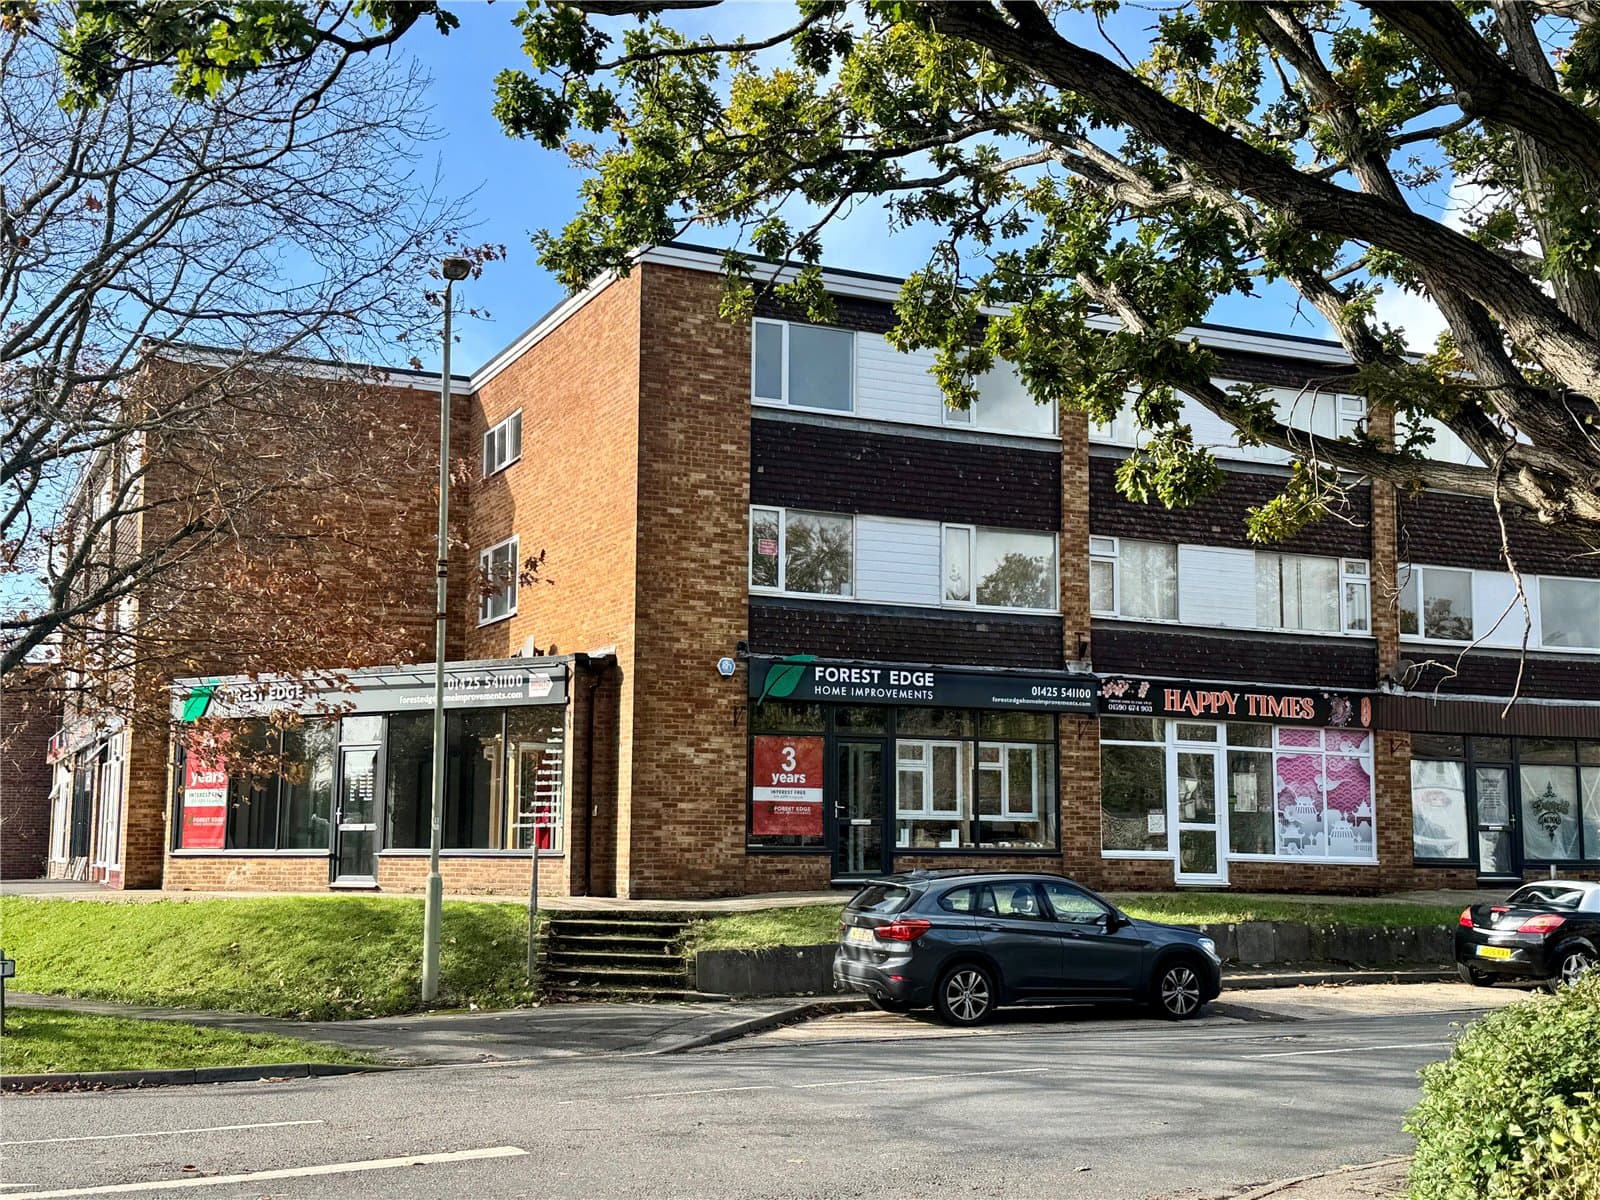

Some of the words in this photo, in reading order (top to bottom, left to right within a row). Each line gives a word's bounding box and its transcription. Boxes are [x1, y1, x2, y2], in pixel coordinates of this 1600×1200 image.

[447, 676, 481, 690] 01425
[484, 674, 523, 689] 541100
[815, 666, 881, 684] FOREST
[889, 670, 935, 687] EDGE
[269, 684, 304, 700] EDGE
[399, 691, 523, 705] forestedgmeimprovements.com
[814, 685, 848, 696] HOME
[851, 687, 934, 700] IMPROVEMENTS
[1031, 686, 1058, 697] 01425
[1060, 688, 1091, 698] 541100
[1163, 688, 1240, 717] HAPPY
[1244, 693, 1315, 720] TIMES
[781, 746, 797, 772] 3
[191, 771, 225, 786] years
[771, 773, 806, 785] years
